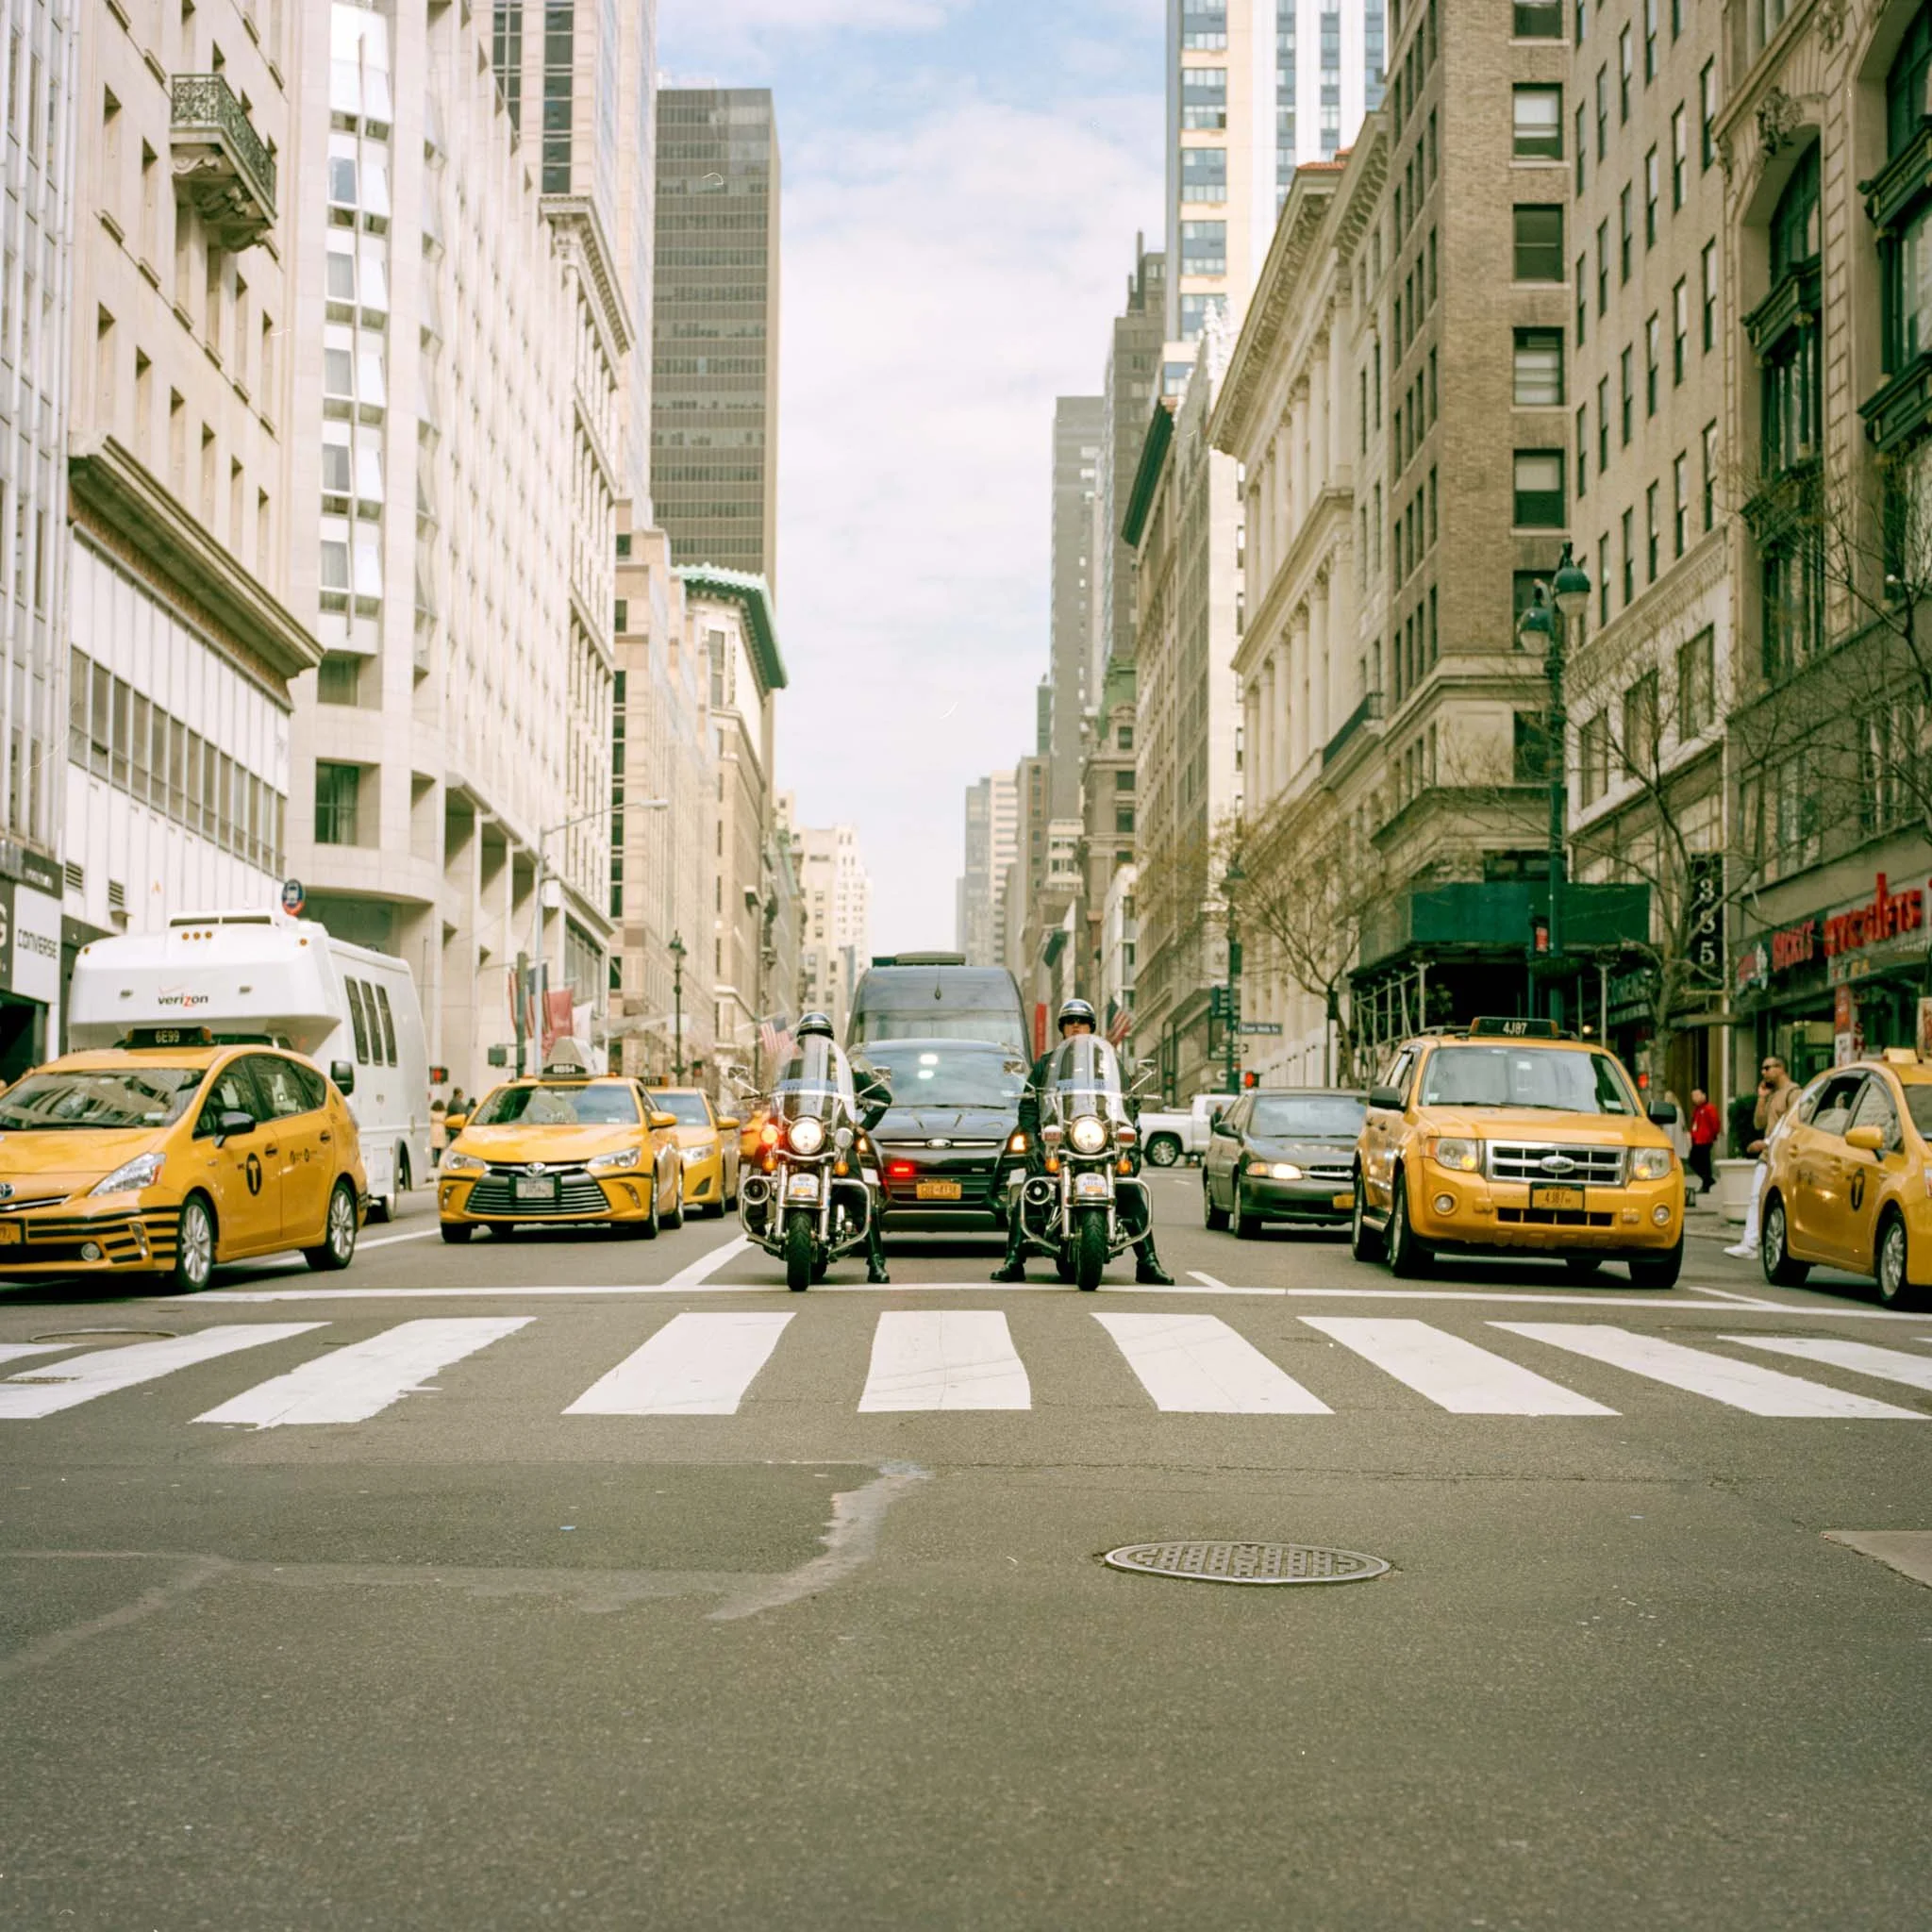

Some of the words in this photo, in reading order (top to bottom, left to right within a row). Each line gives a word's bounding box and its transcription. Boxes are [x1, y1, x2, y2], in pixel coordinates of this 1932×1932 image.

[18, 928, 58, 959] CONVERSE
[158, 992, 208, 1008] verizon
[1503, 1021, 1528, 1035] 4J87
[155, 1030, 180, 1043] 6E99
